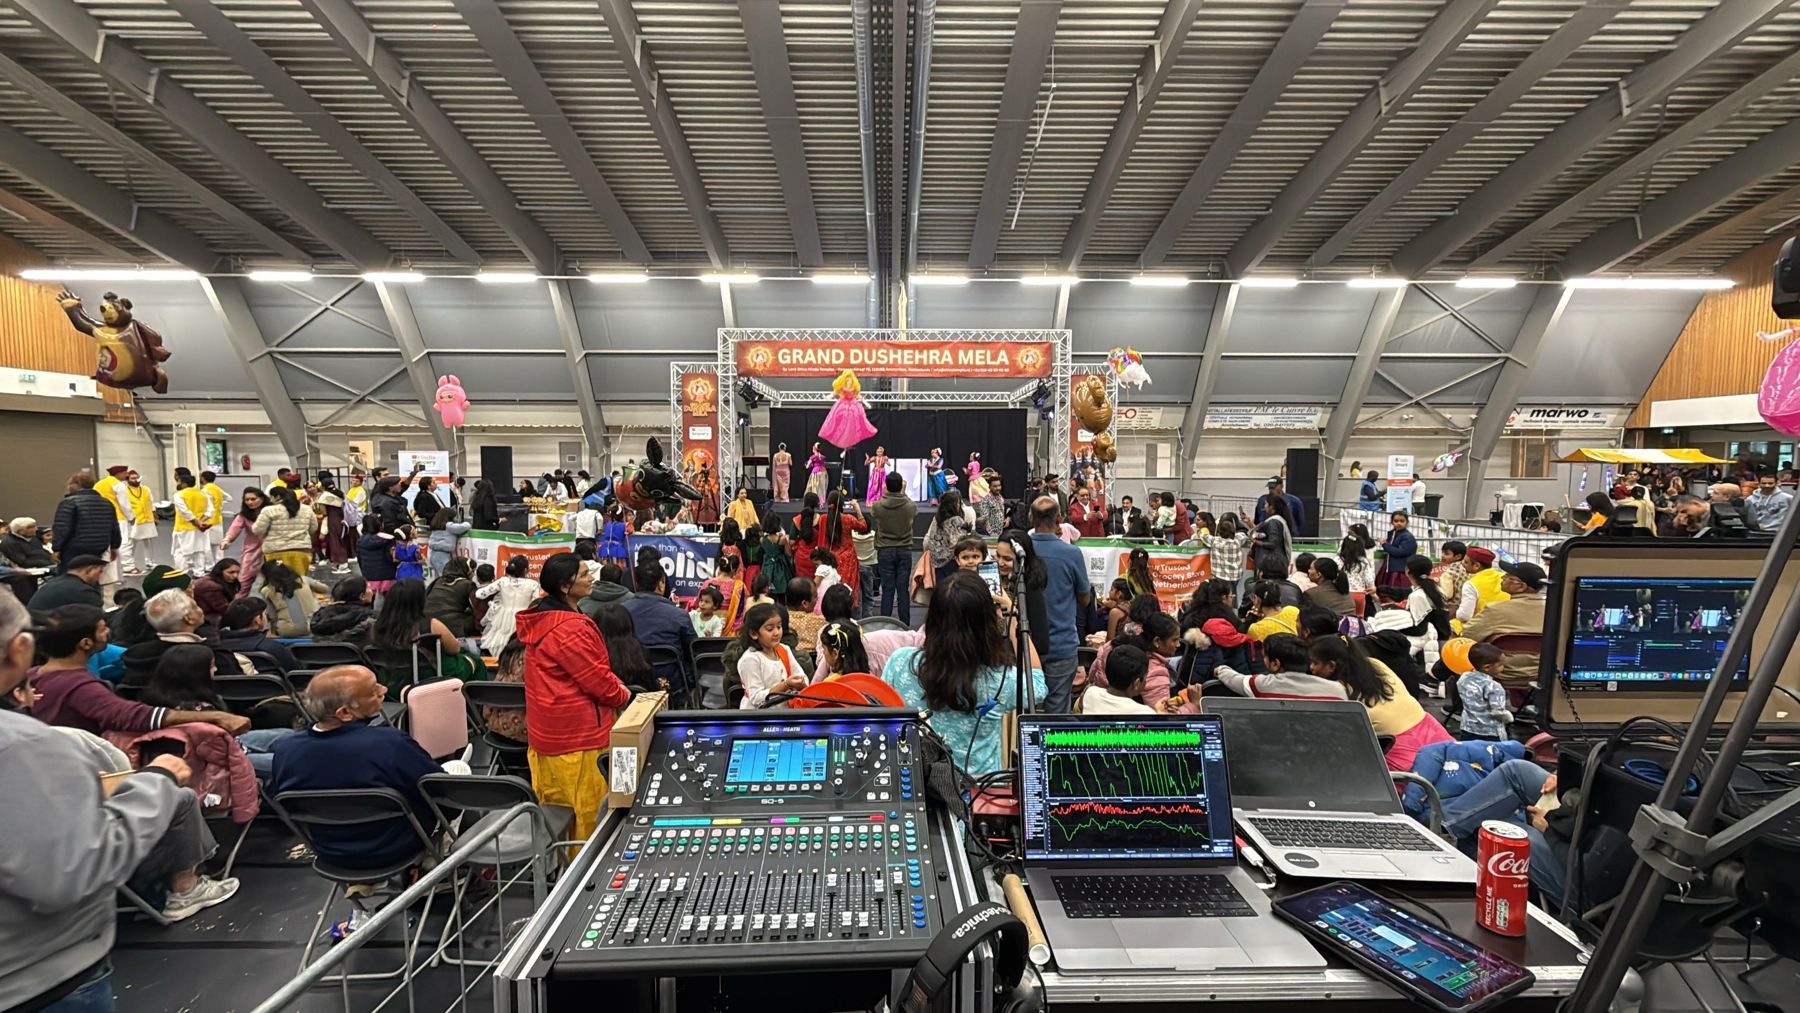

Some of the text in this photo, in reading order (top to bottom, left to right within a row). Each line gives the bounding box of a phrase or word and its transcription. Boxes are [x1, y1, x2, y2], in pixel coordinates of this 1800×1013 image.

[777, 348, 1010, 365] GRAND DUSHEHRA MELA
[1530, 408, 1589, 418] marwo
[658, 543, 678, 552] than
[634, 551, 716, 579] olid
[1160, 563, 1191, 571] Trusted
[1152, 580, 1201, 590] Netherlands
[1486, 885, 1493, 898] ME
